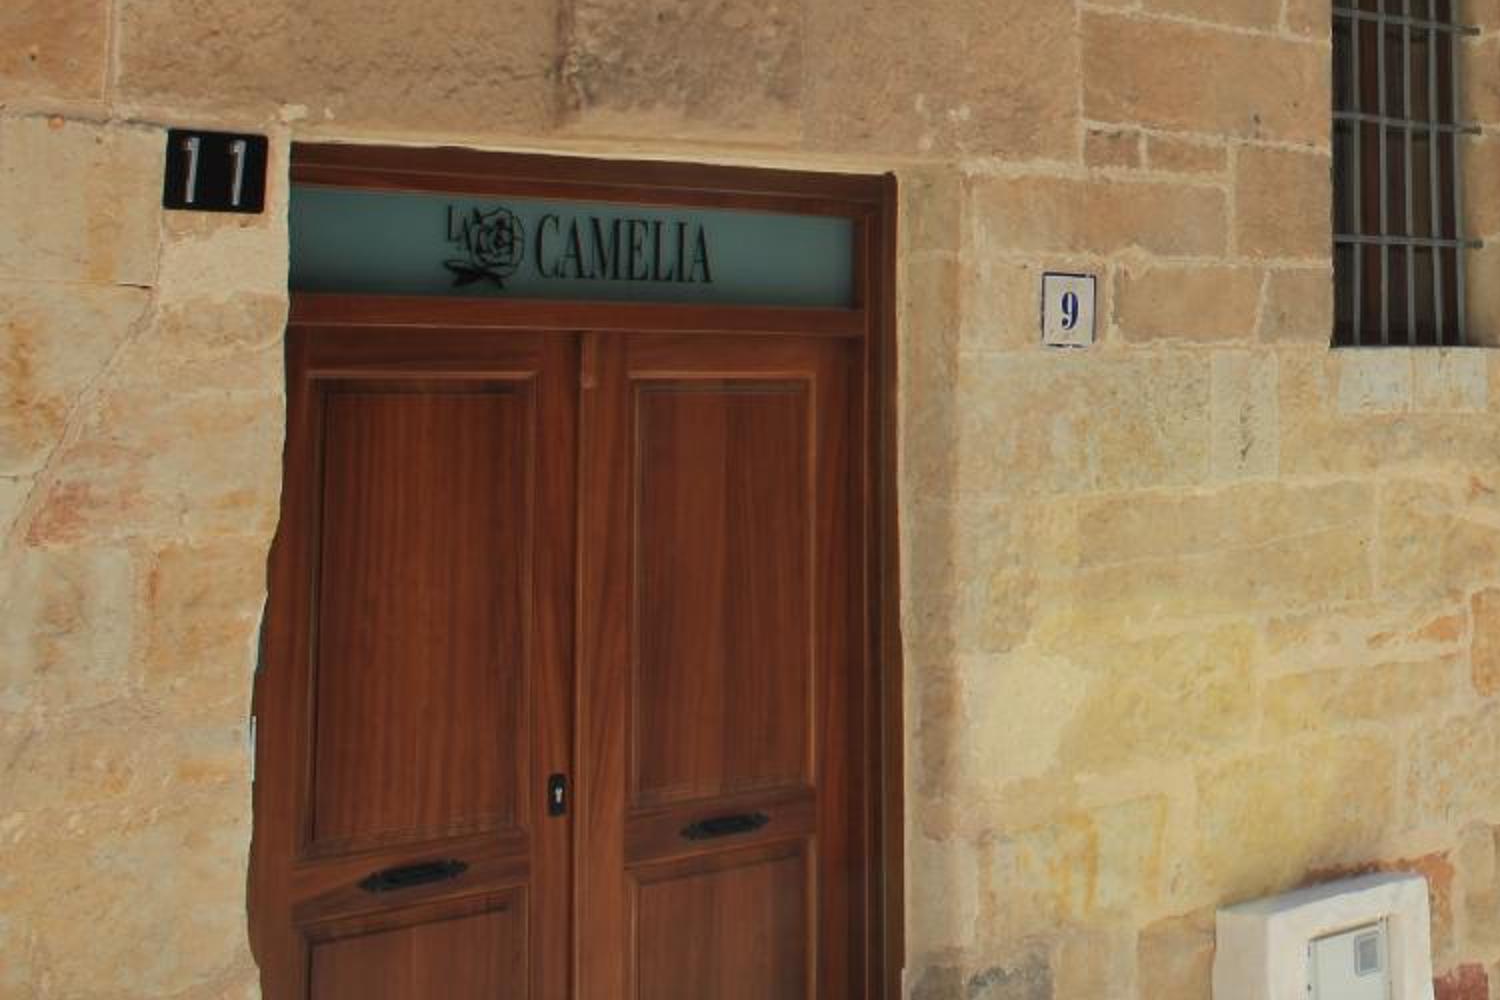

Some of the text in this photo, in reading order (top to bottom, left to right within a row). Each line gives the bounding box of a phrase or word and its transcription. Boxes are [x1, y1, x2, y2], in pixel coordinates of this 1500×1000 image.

[182, 136, 247, 206] 11
[534, 213, 713, 284] CAMELIA
[1061, 291, 1079, 329] 9
